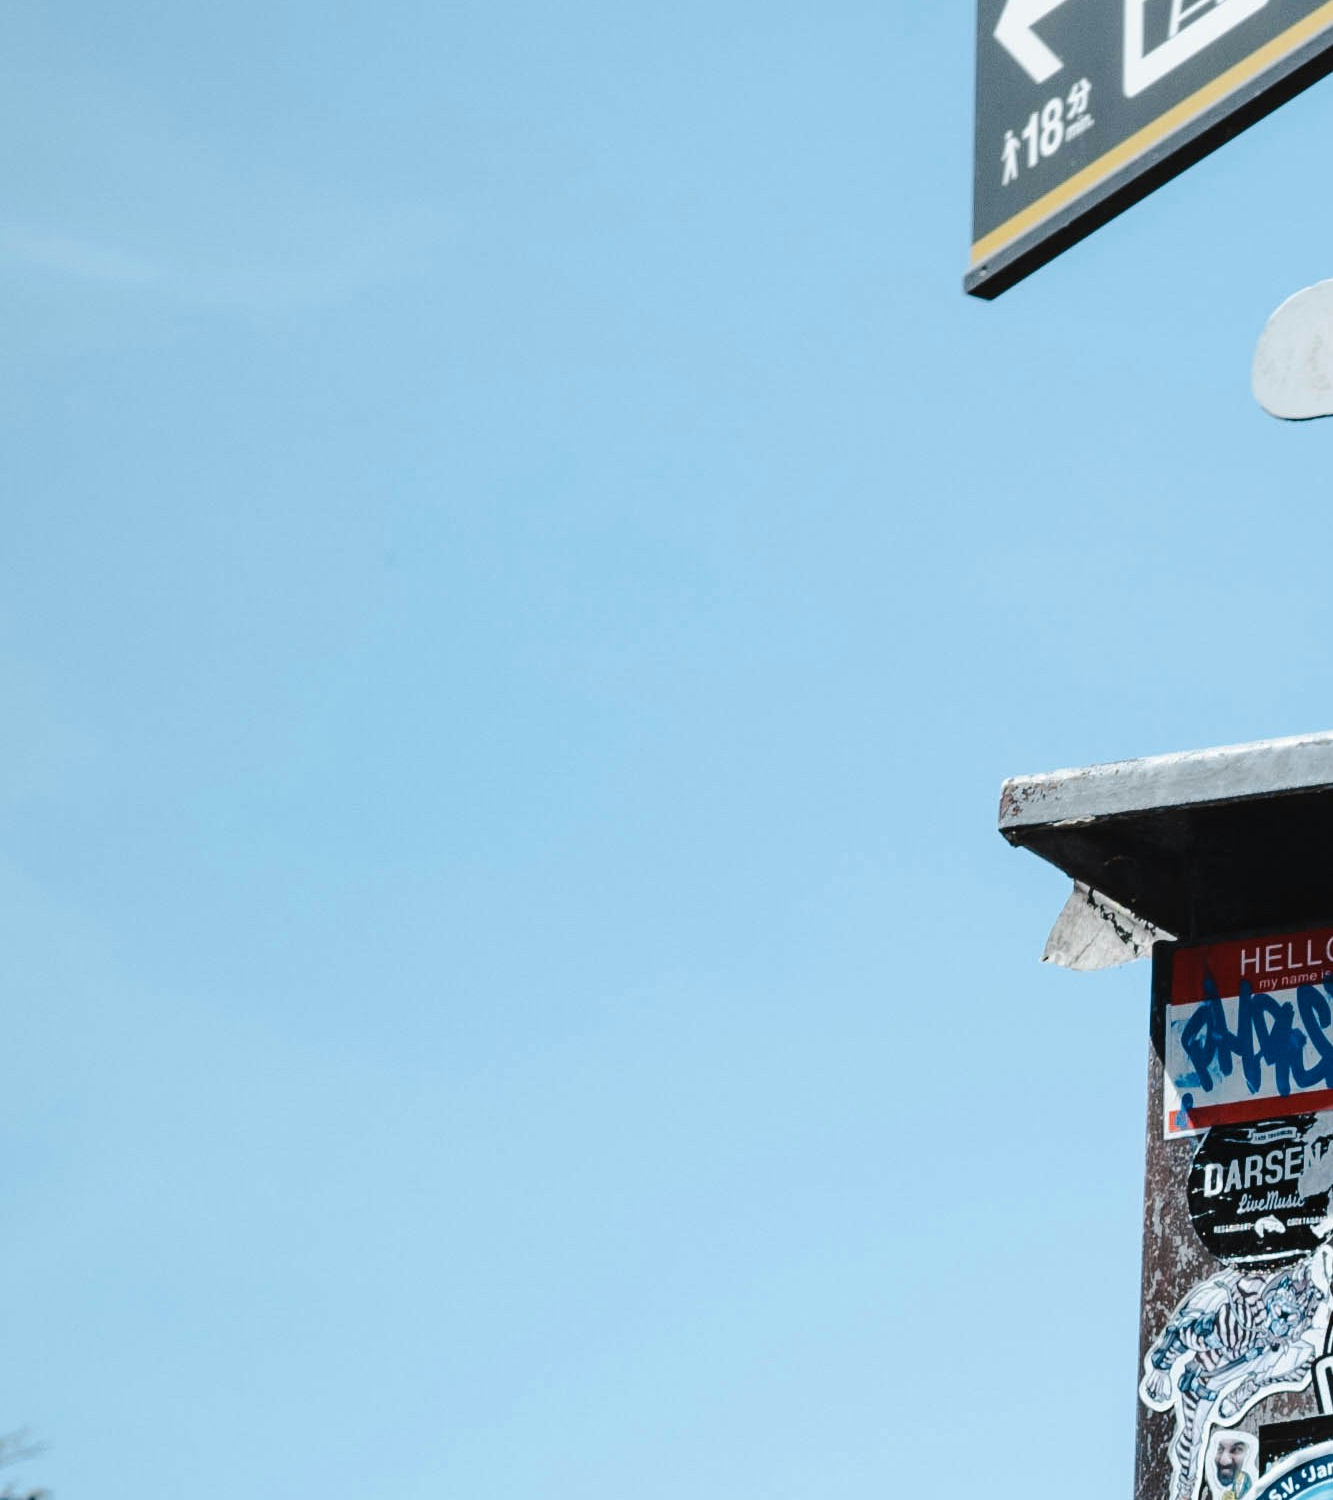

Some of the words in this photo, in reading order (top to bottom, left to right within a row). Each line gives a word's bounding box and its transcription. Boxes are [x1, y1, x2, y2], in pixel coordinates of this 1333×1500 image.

[1022, 103, 1063, 171] 18
[1259, 977, 1278, 990] my
[1281, 972, 1317, 988] name
